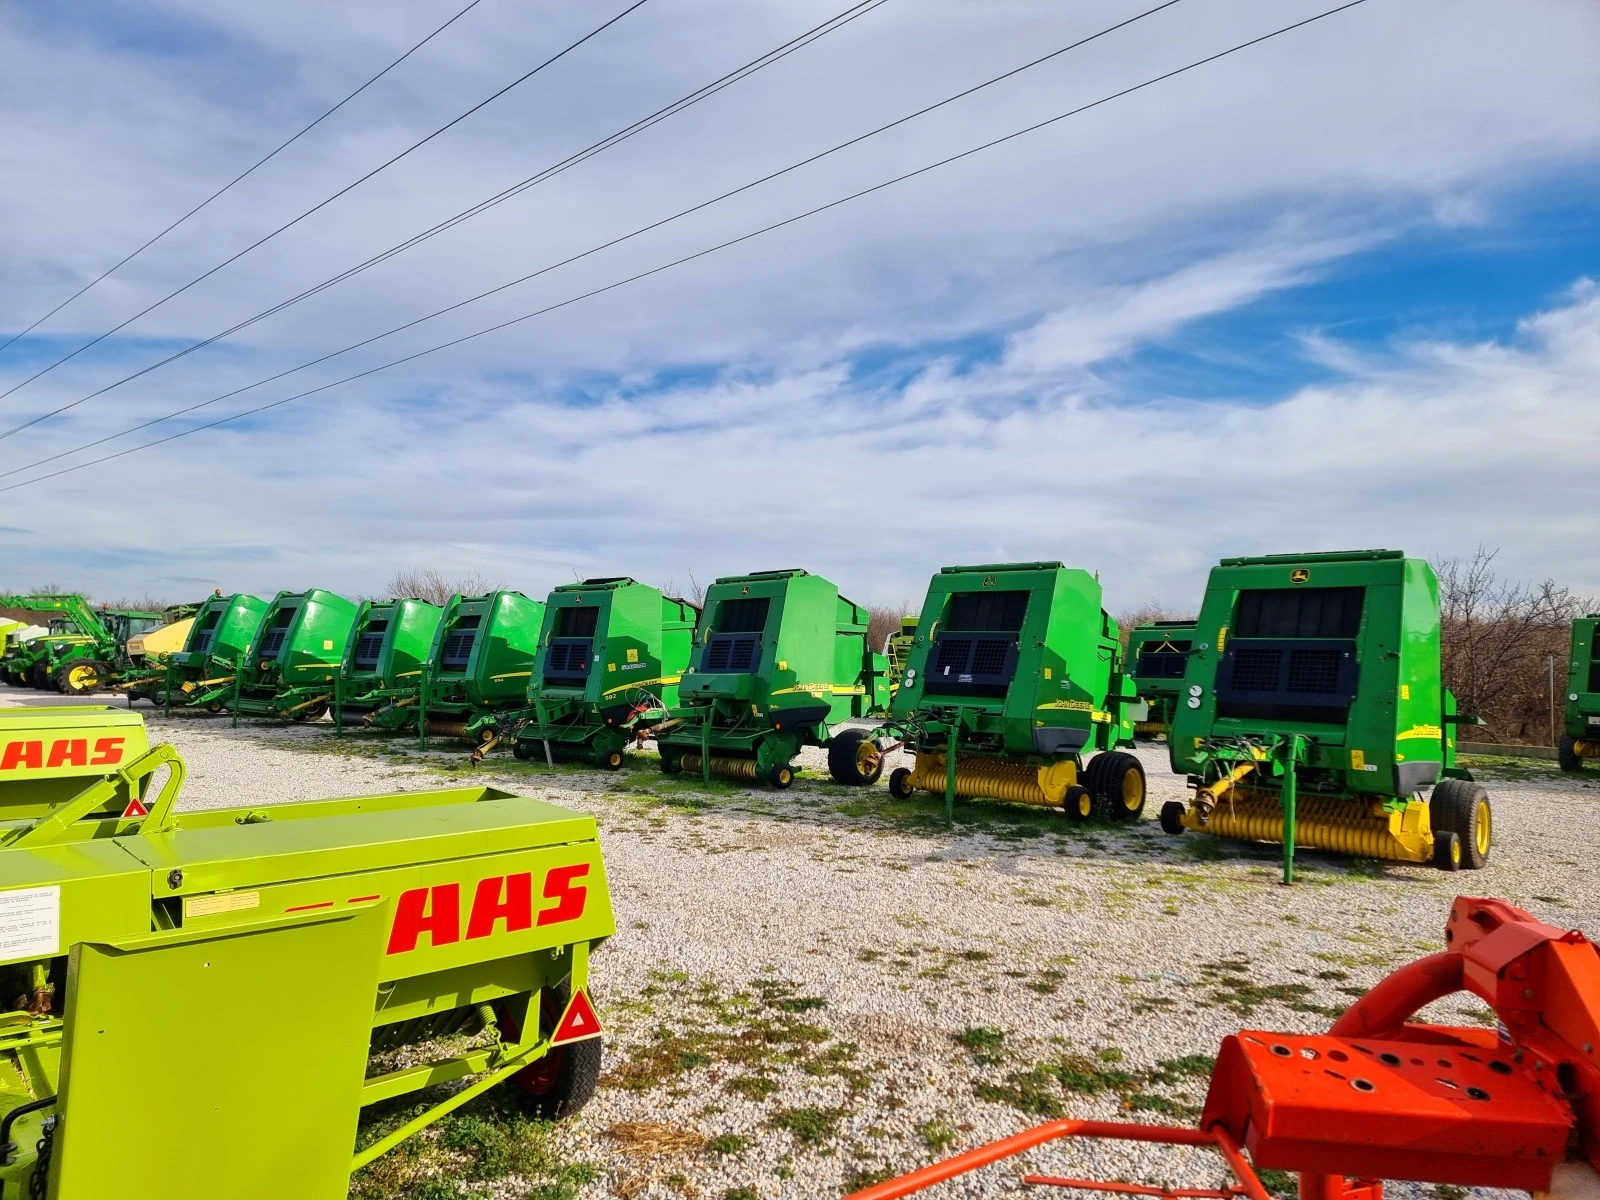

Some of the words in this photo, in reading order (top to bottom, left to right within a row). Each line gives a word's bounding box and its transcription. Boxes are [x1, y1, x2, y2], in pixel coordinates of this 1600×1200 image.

[1055, 698, 1071, 708] JOHN
[1070, 700, 1090, 710] DEERE
[286, 863, 591, 956] AAS
